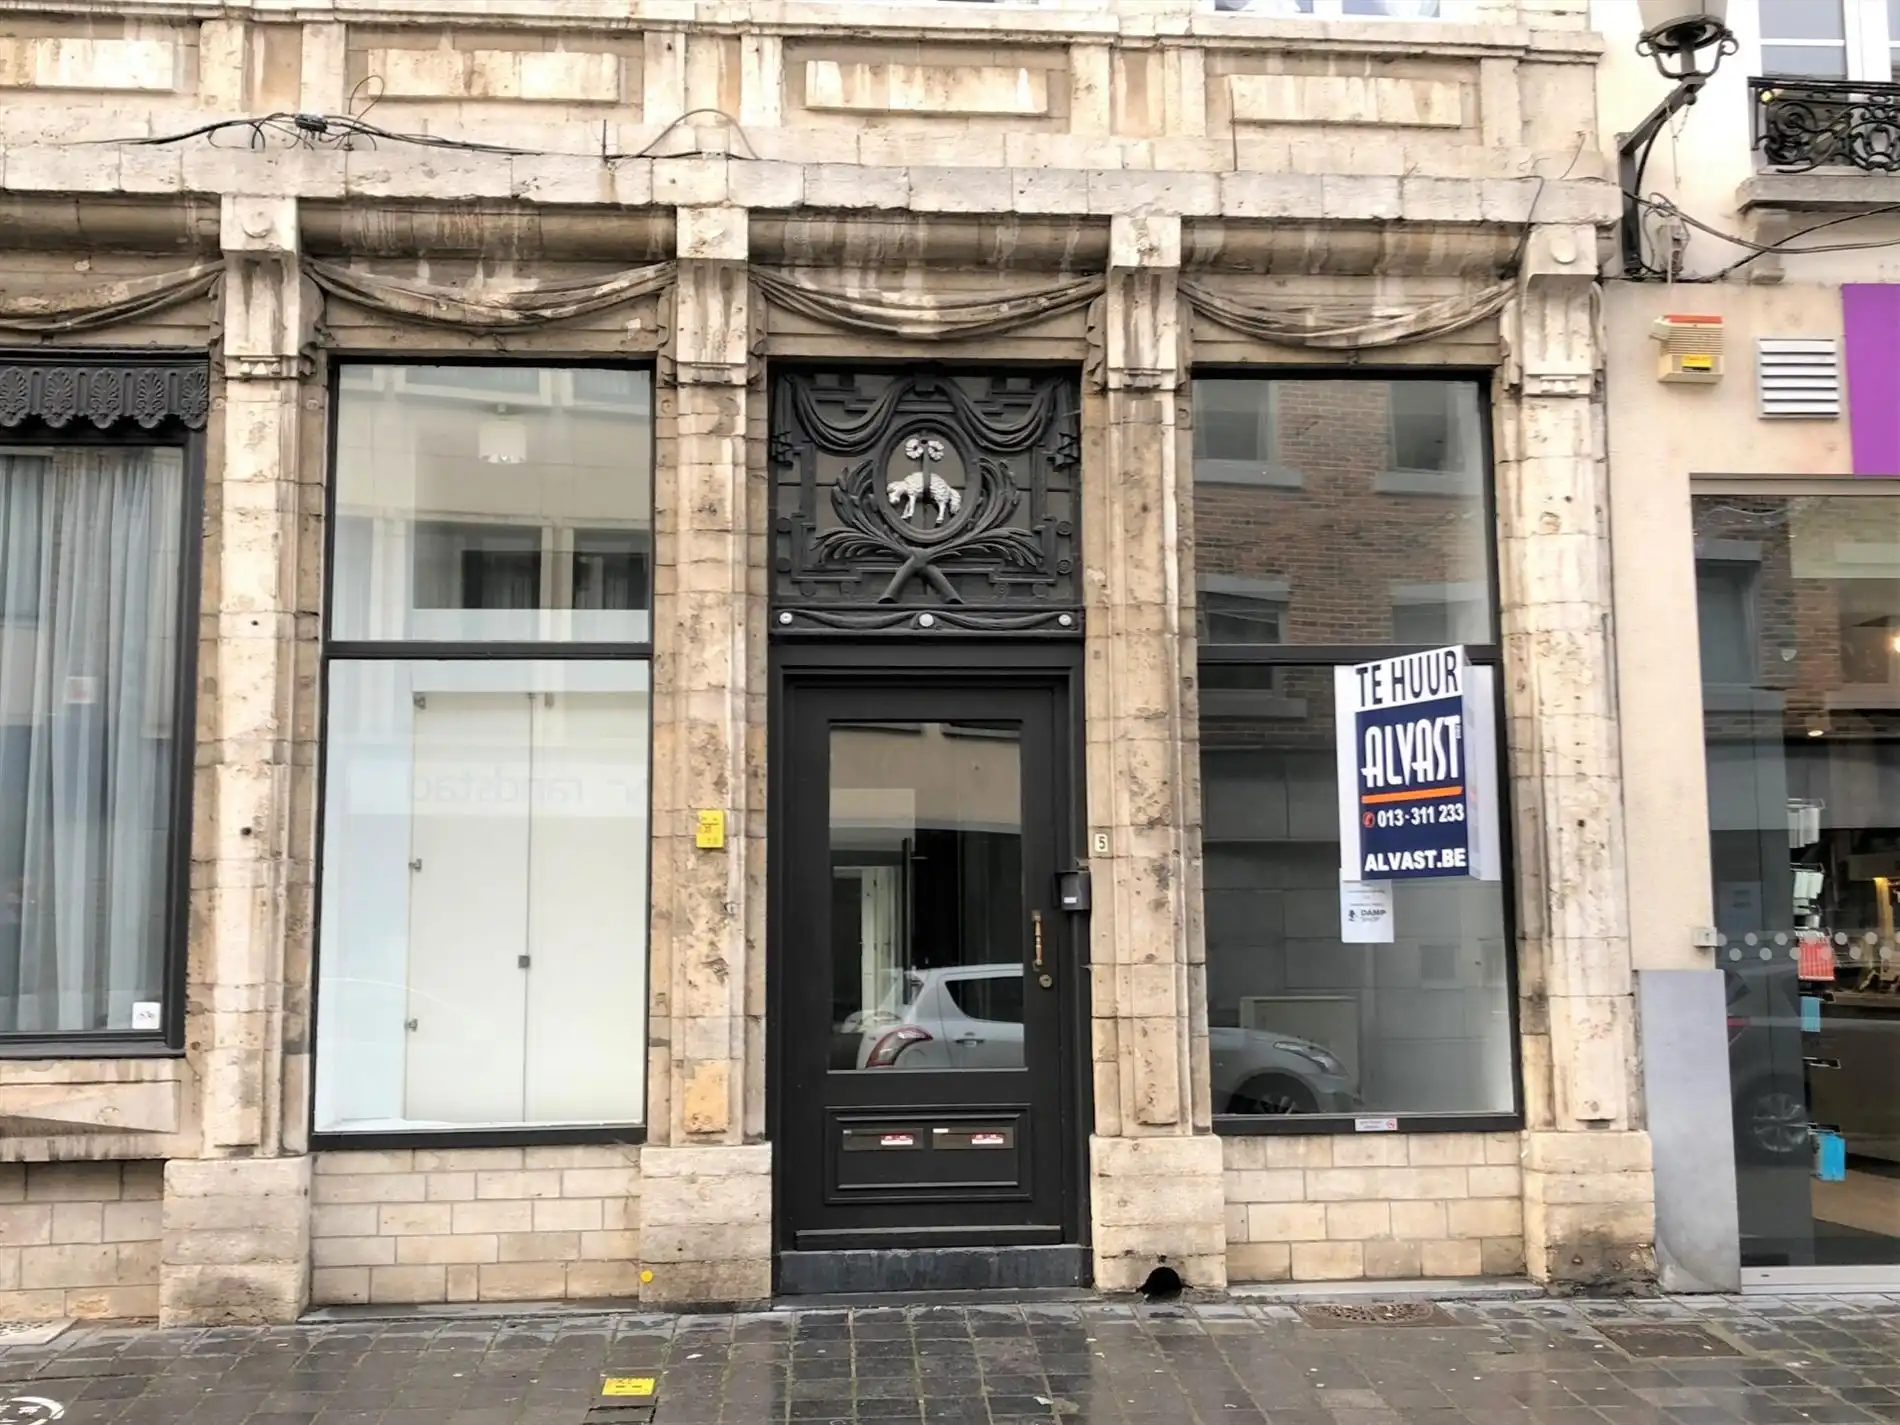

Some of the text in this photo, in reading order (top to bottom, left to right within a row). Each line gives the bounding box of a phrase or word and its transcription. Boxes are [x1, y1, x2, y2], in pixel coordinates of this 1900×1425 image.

[1356, 650, 1458, 707] TE HUUR
[1360, 715, 1461, 787] ALVAST
[1438, 803, 1464, 822] 233
[1098, 836, 1106, 849] 5
[1364, 847, 1466, 871] ALVAST.BE
